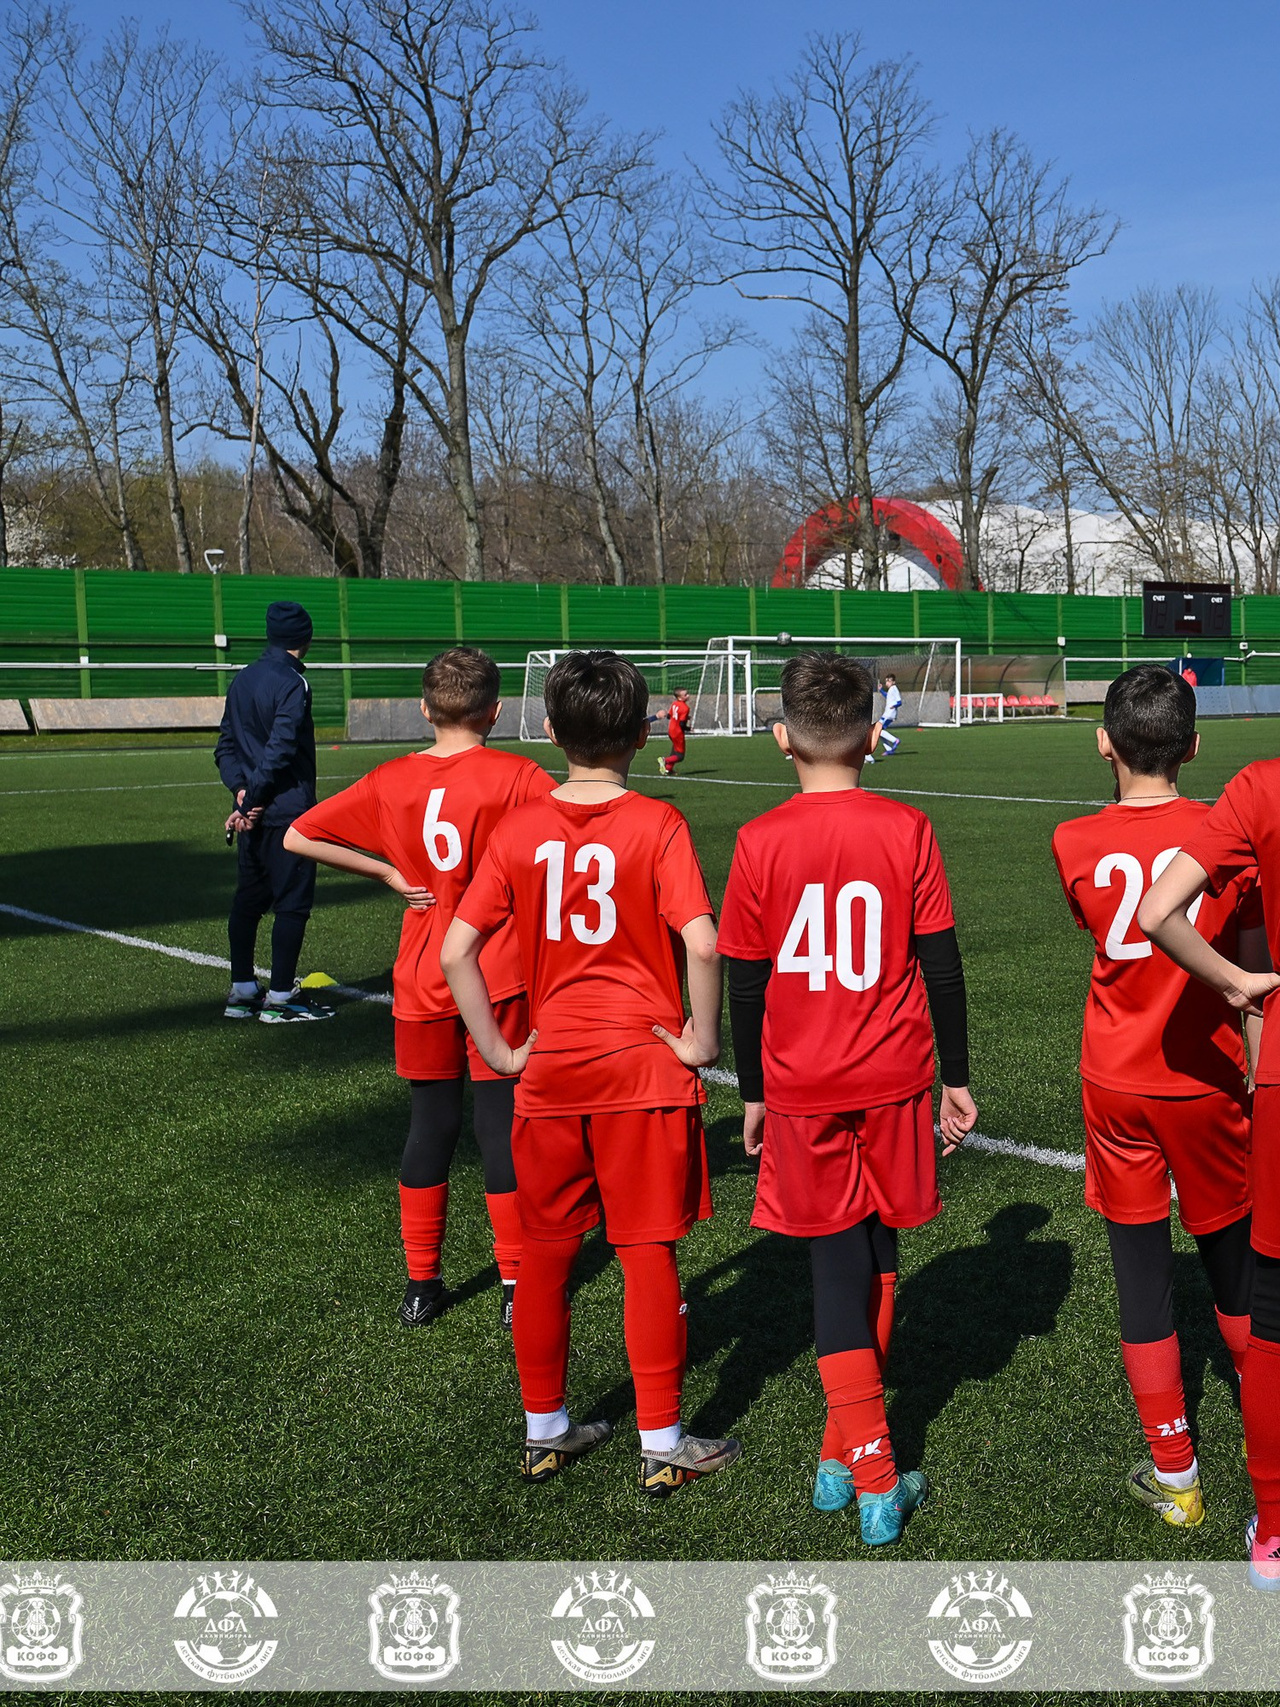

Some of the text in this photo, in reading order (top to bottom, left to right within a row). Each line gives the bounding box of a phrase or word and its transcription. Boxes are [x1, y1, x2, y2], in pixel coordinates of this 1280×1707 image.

[422, 787, 463, 872] 6
[534, 840, 617, 945] 13
[777, 880, 883, 992] 40
